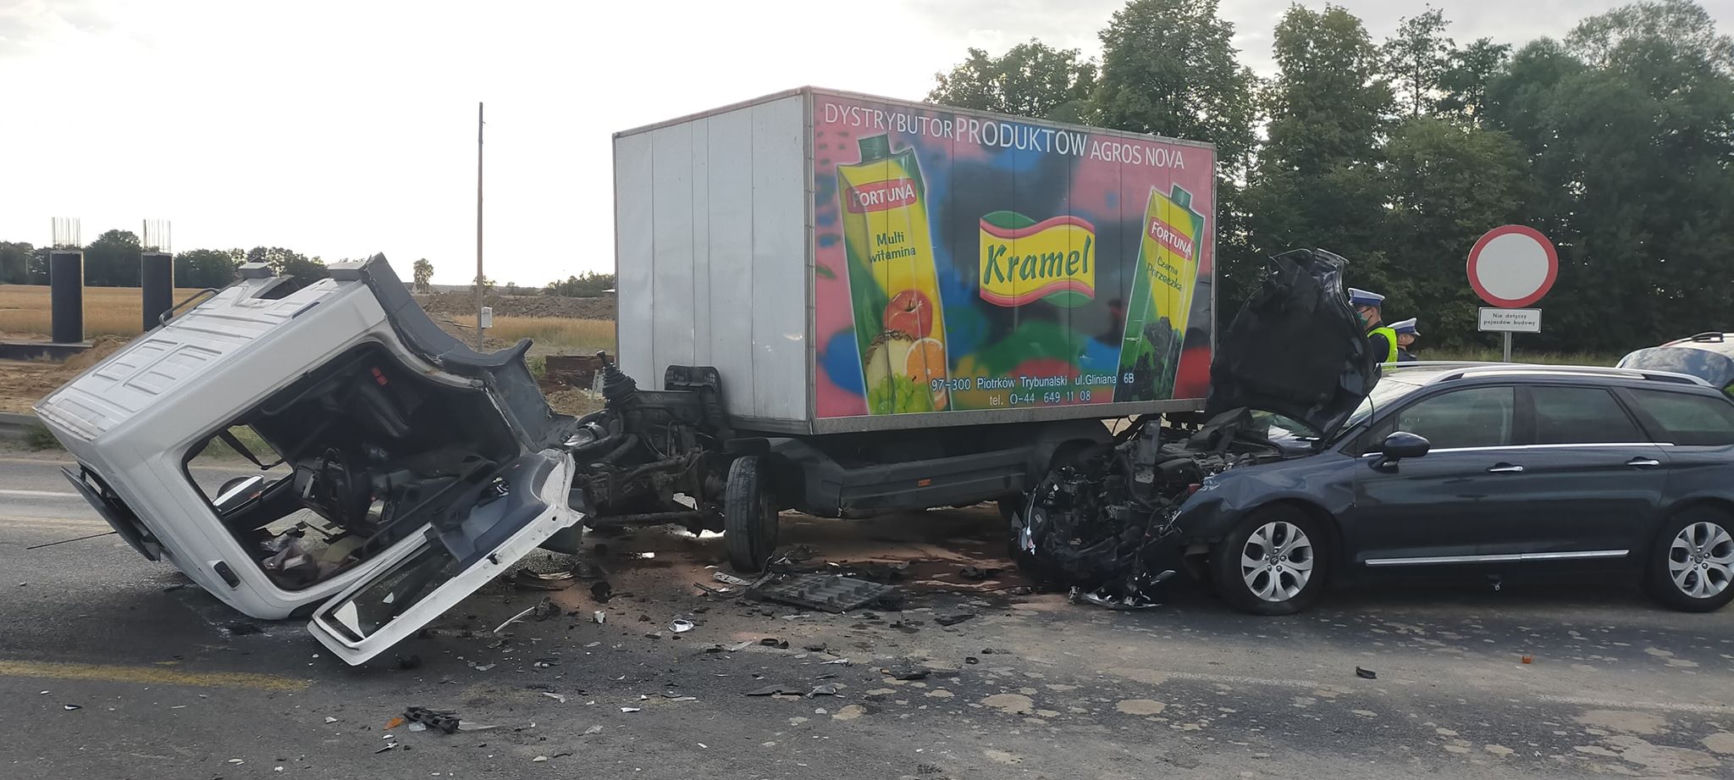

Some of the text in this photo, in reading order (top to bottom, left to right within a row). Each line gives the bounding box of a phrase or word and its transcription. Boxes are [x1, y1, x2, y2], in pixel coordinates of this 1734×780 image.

[825, 103, 953, 139] DYSTRYBUTOR
[1090, 141, 1142, 165] AGROS
[1145, 147, 1185, 169] NOVA
[852, 184, 915, 208] FORTUNA
[876, 231, 905, 246] Multi
[1151, 221, 1192, 257] FORTUNA
[868, 247, 916, 263] witamina
[983, 234, 1091, 285] Kramel
[931, 378, 971, 391] 97-300
[977, 377, 1015, 389] Piotrków
[1020, 375, 1068, 390] Trybunalski
[1123, 372, 1135, 384] 6B
[989, 394, 1004, 406] tel.
[1043, 391, 1060, 403] 649
[1066, 391, 1075, 401] 11
[1079, 390, 1091, 401] 08
